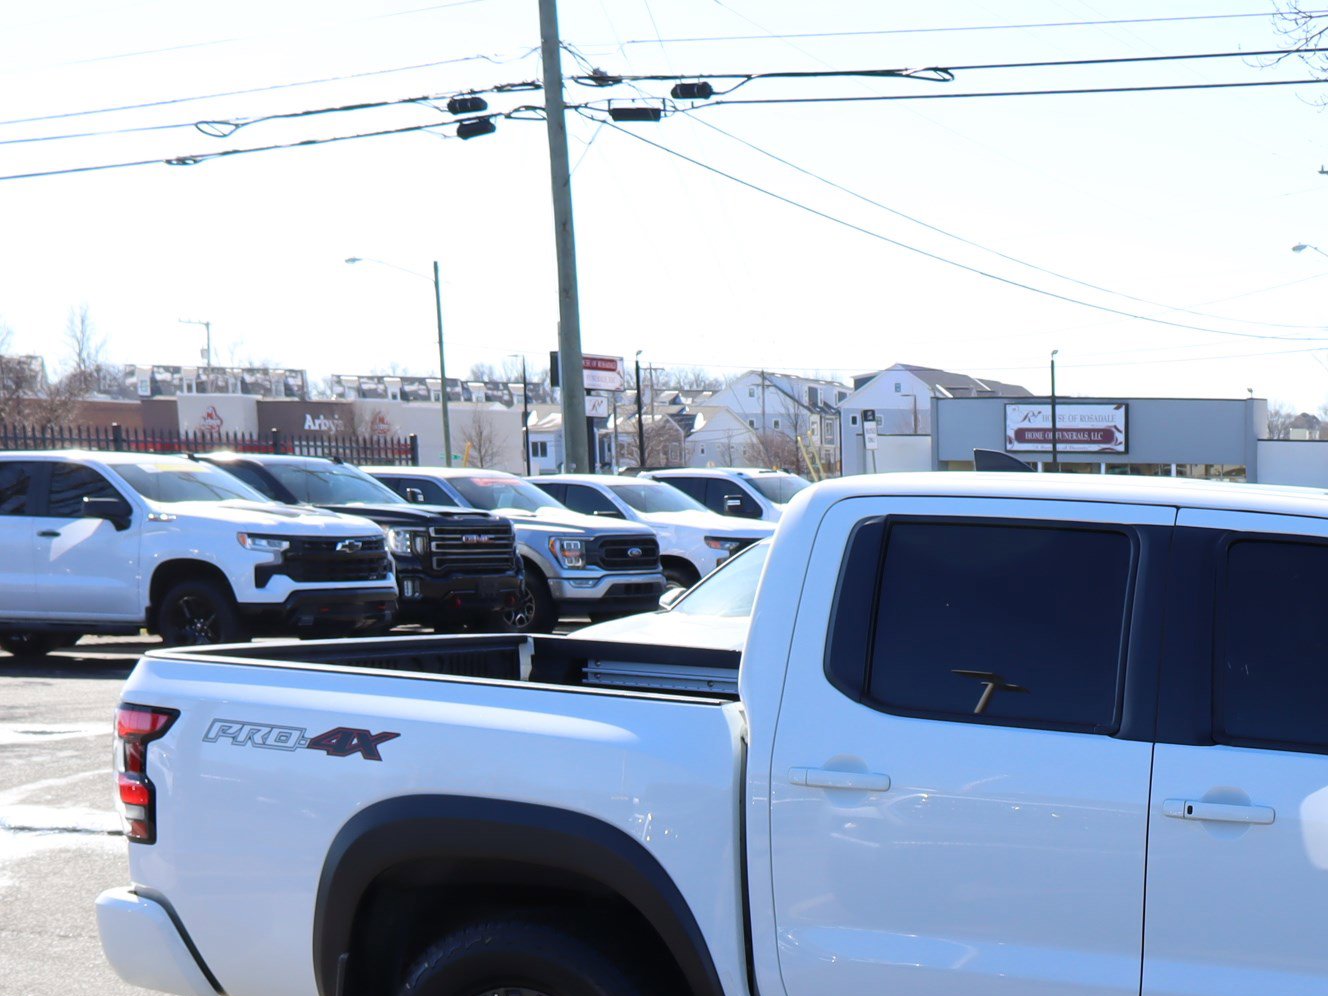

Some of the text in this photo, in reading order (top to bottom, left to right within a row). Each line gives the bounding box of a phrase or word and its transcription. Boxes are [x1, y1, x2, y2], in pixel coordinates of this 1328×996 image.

[1042, 414, 1065, 423] HOSE
[304, 413, 345, 435] Arby's
[1025, 431, 1042, 440] HOME
[1091, 432, 1103, 440] LLC
